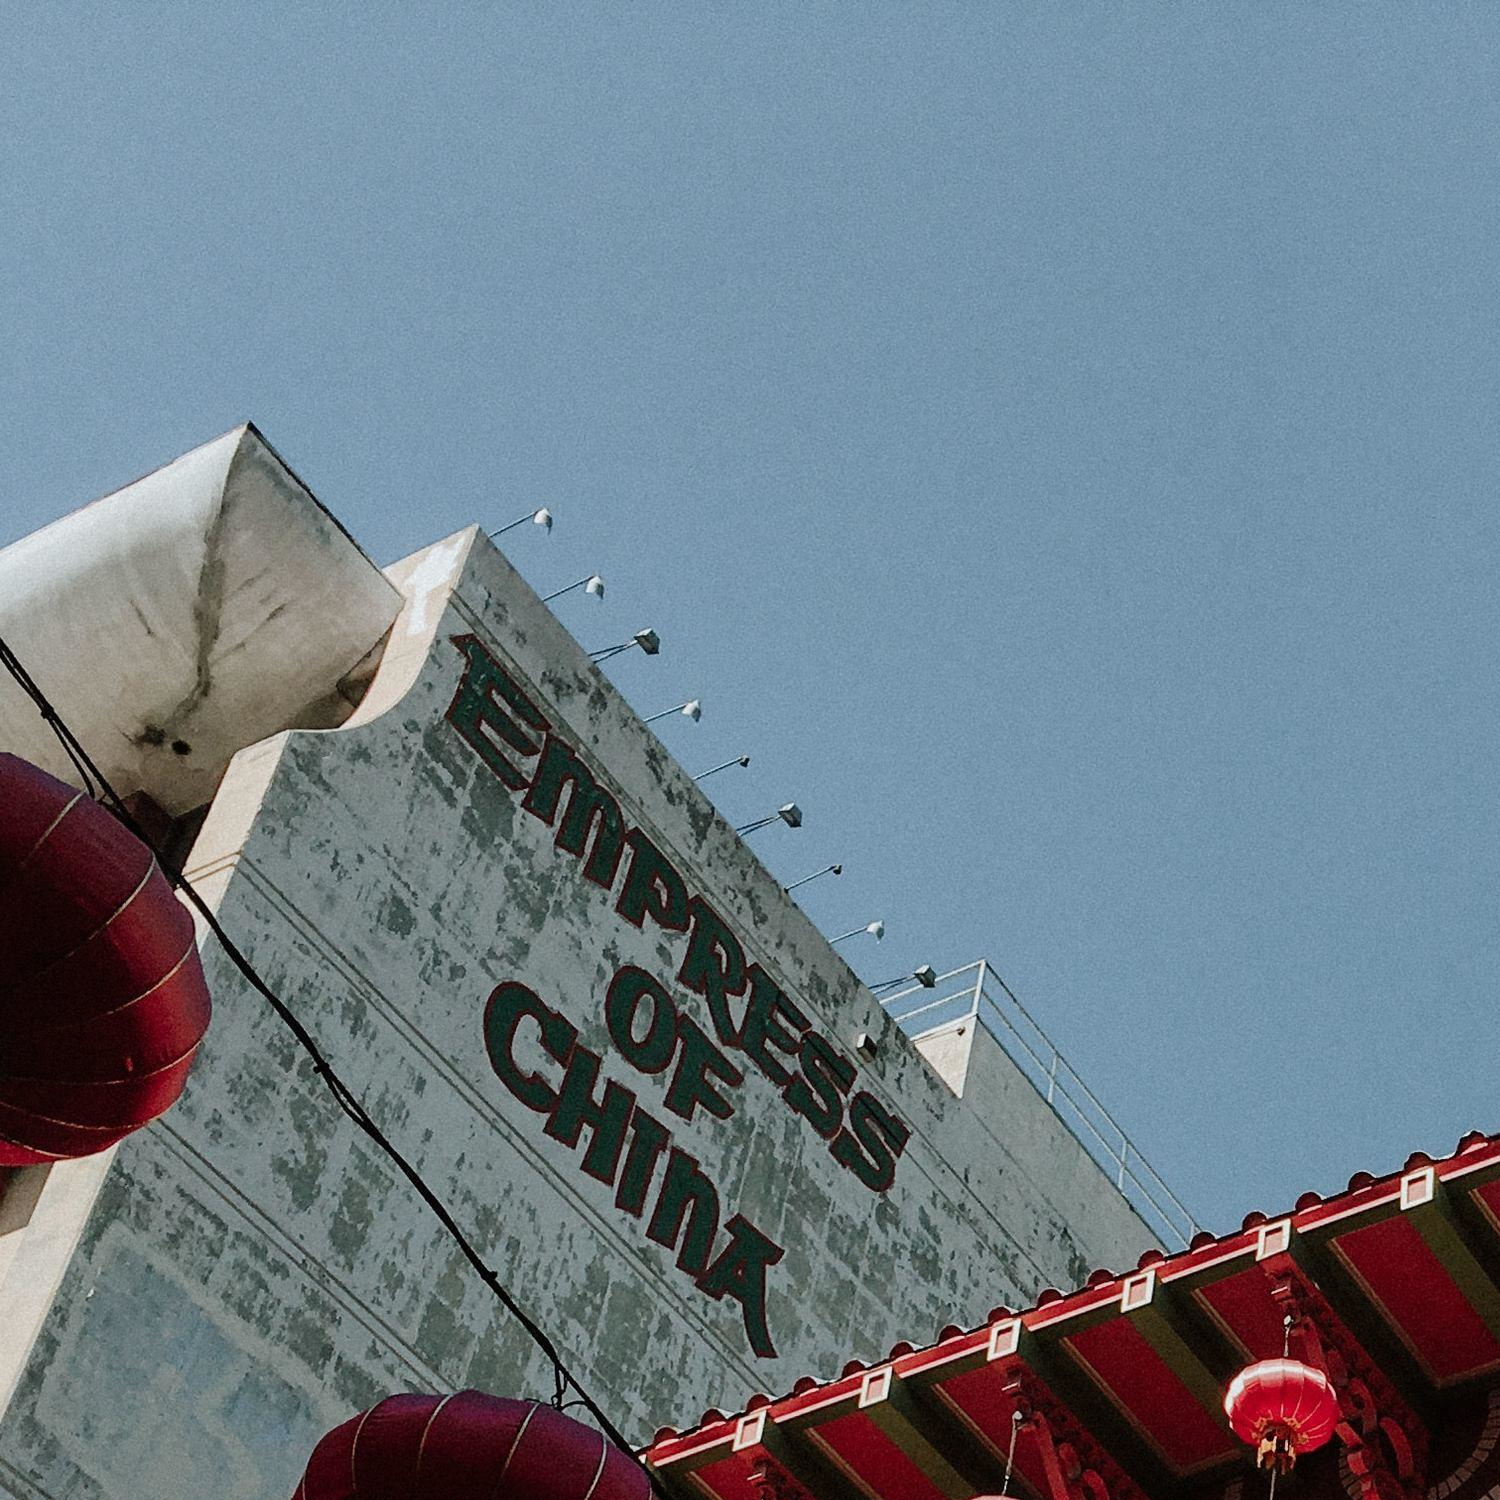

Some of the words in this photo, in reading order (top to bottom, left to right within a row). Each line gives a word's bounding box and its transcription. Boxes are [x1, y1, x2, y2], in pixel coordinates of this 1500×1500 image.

[447, 632, 911, 1194] EMPRESS
[604, 965, 744, 1121] OF
[483, 981, 784, 1359] CHINA
